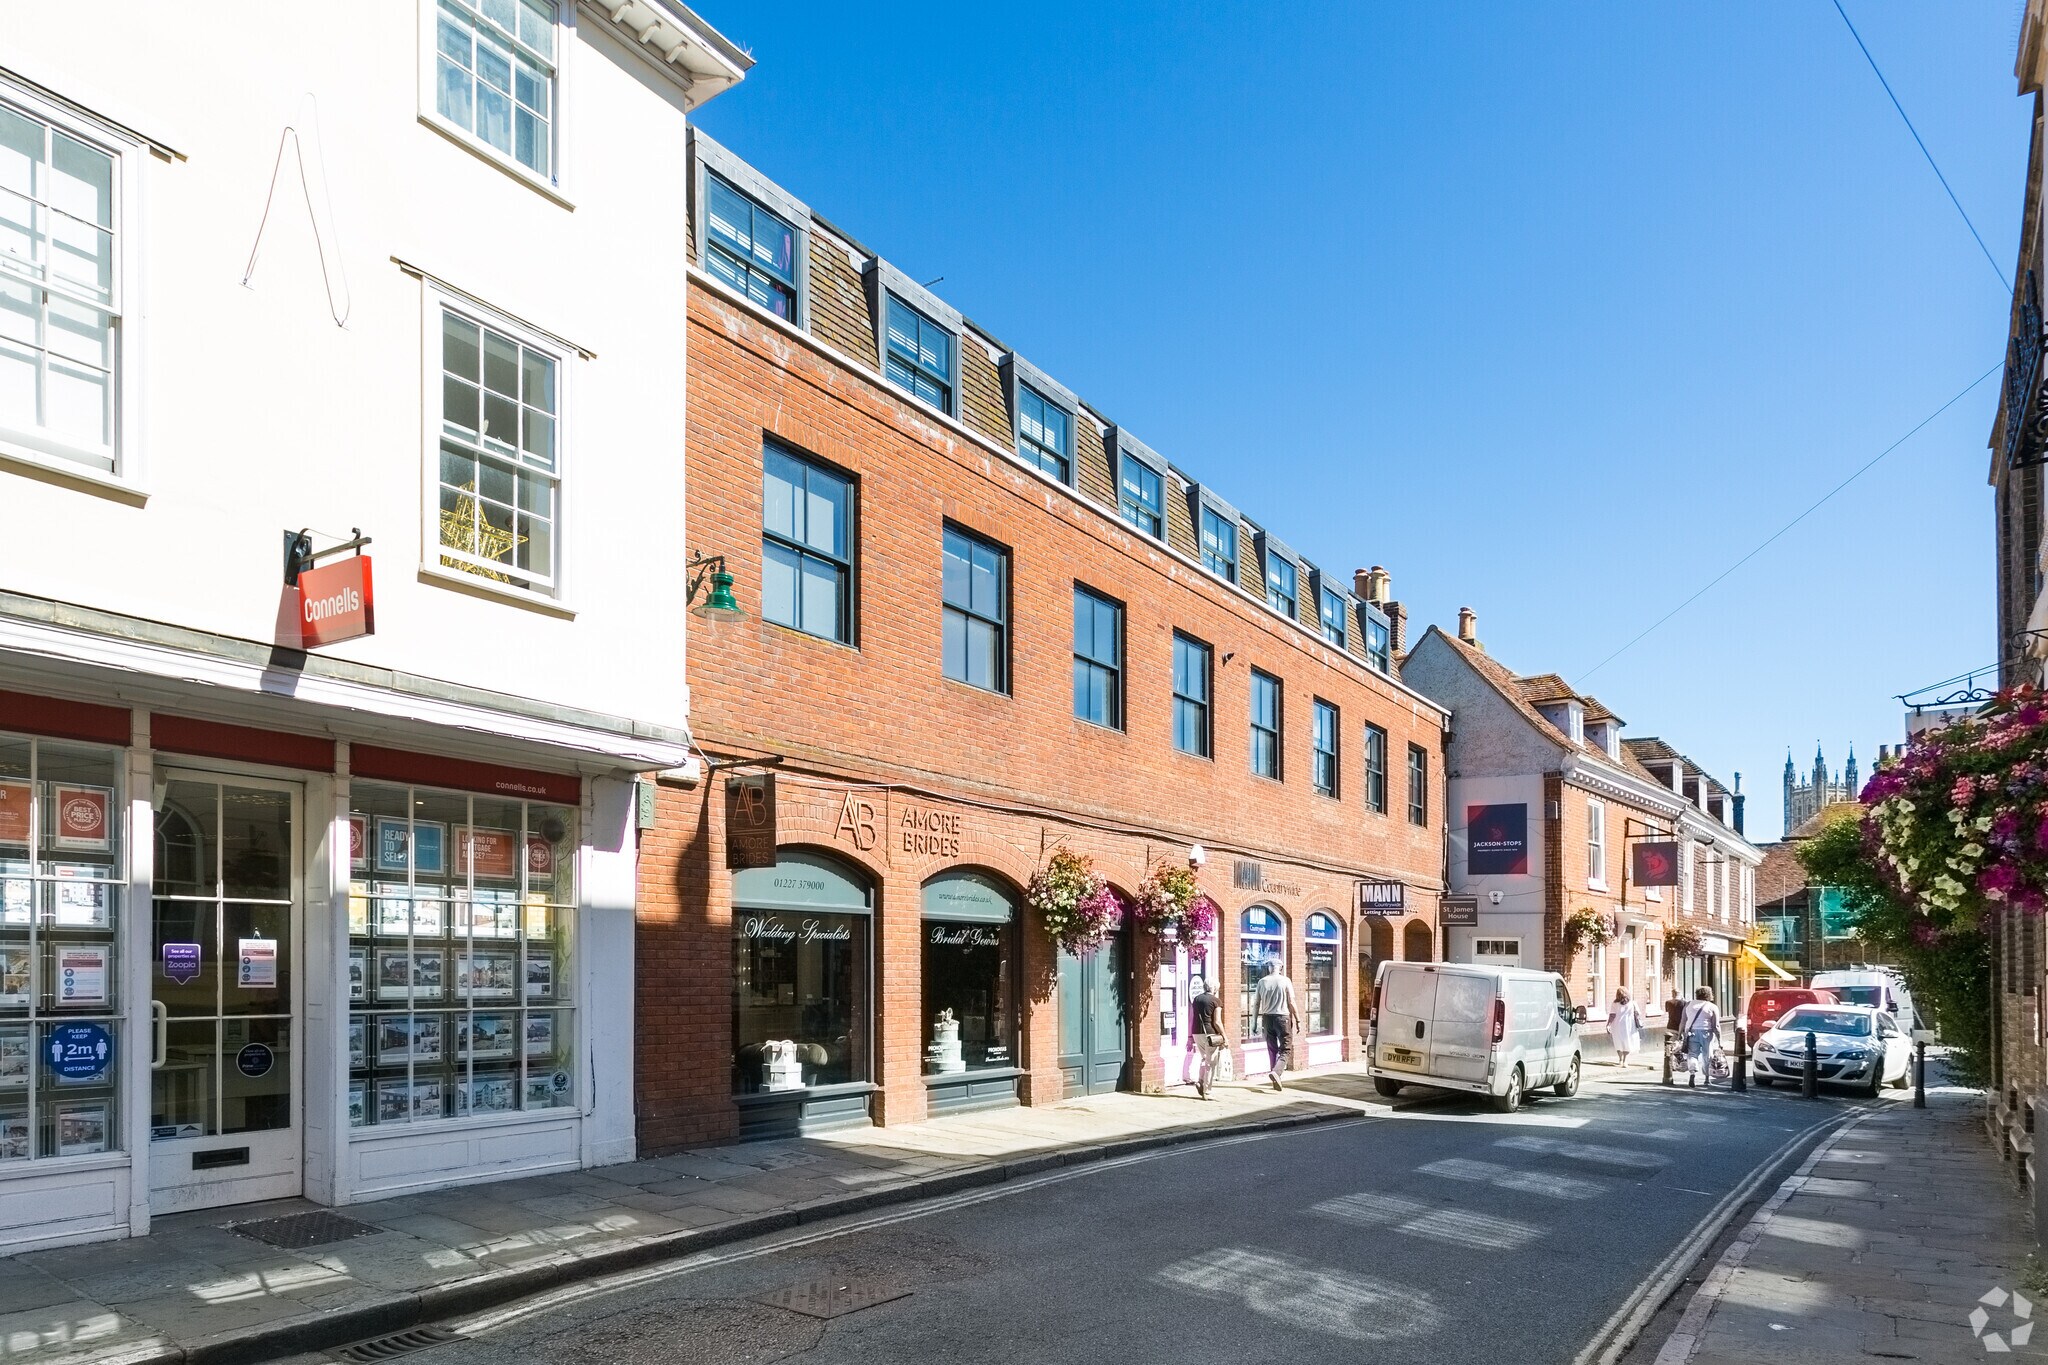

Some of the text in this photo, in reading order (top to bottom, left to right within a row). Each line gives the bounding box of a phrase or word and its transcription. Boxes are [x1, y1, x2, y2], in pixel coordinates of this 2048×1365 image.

[304, 587, 360, 623] Connells
[495, 781, 547, 795] connells.co.uk
[71, 811, 95, 820] PRICE
[834, 790, 876, 851] AB
[900, 806, 961, 835] AMORE
[384, 840, 394, 852] TO
[462, 834, 497, 845] LOKING FOR
[732, 837, 769, 851] AMORE
[903, 831, 961, 858] BRIDES
[1473, 840, 1522, 848] JACKSON-STOPS
[461, 843, 491, 853] MTGAGE
[732, 852, 769, 866] BRIDES
[774, 878, 825, 891] 01227 379000
[1361, 884, 1401, 903] MANN
[1249, 908, 1266, 925] MANN
[744, 916, 851, 945] Wedding Specialists
[930, 926, 1000, 946] Bridal Gowns
[168, 960, 196, 969] Zoopla
[67, 1043, 92, 1055] 2m
[1402, 1055, 1416, 1064] RFF
